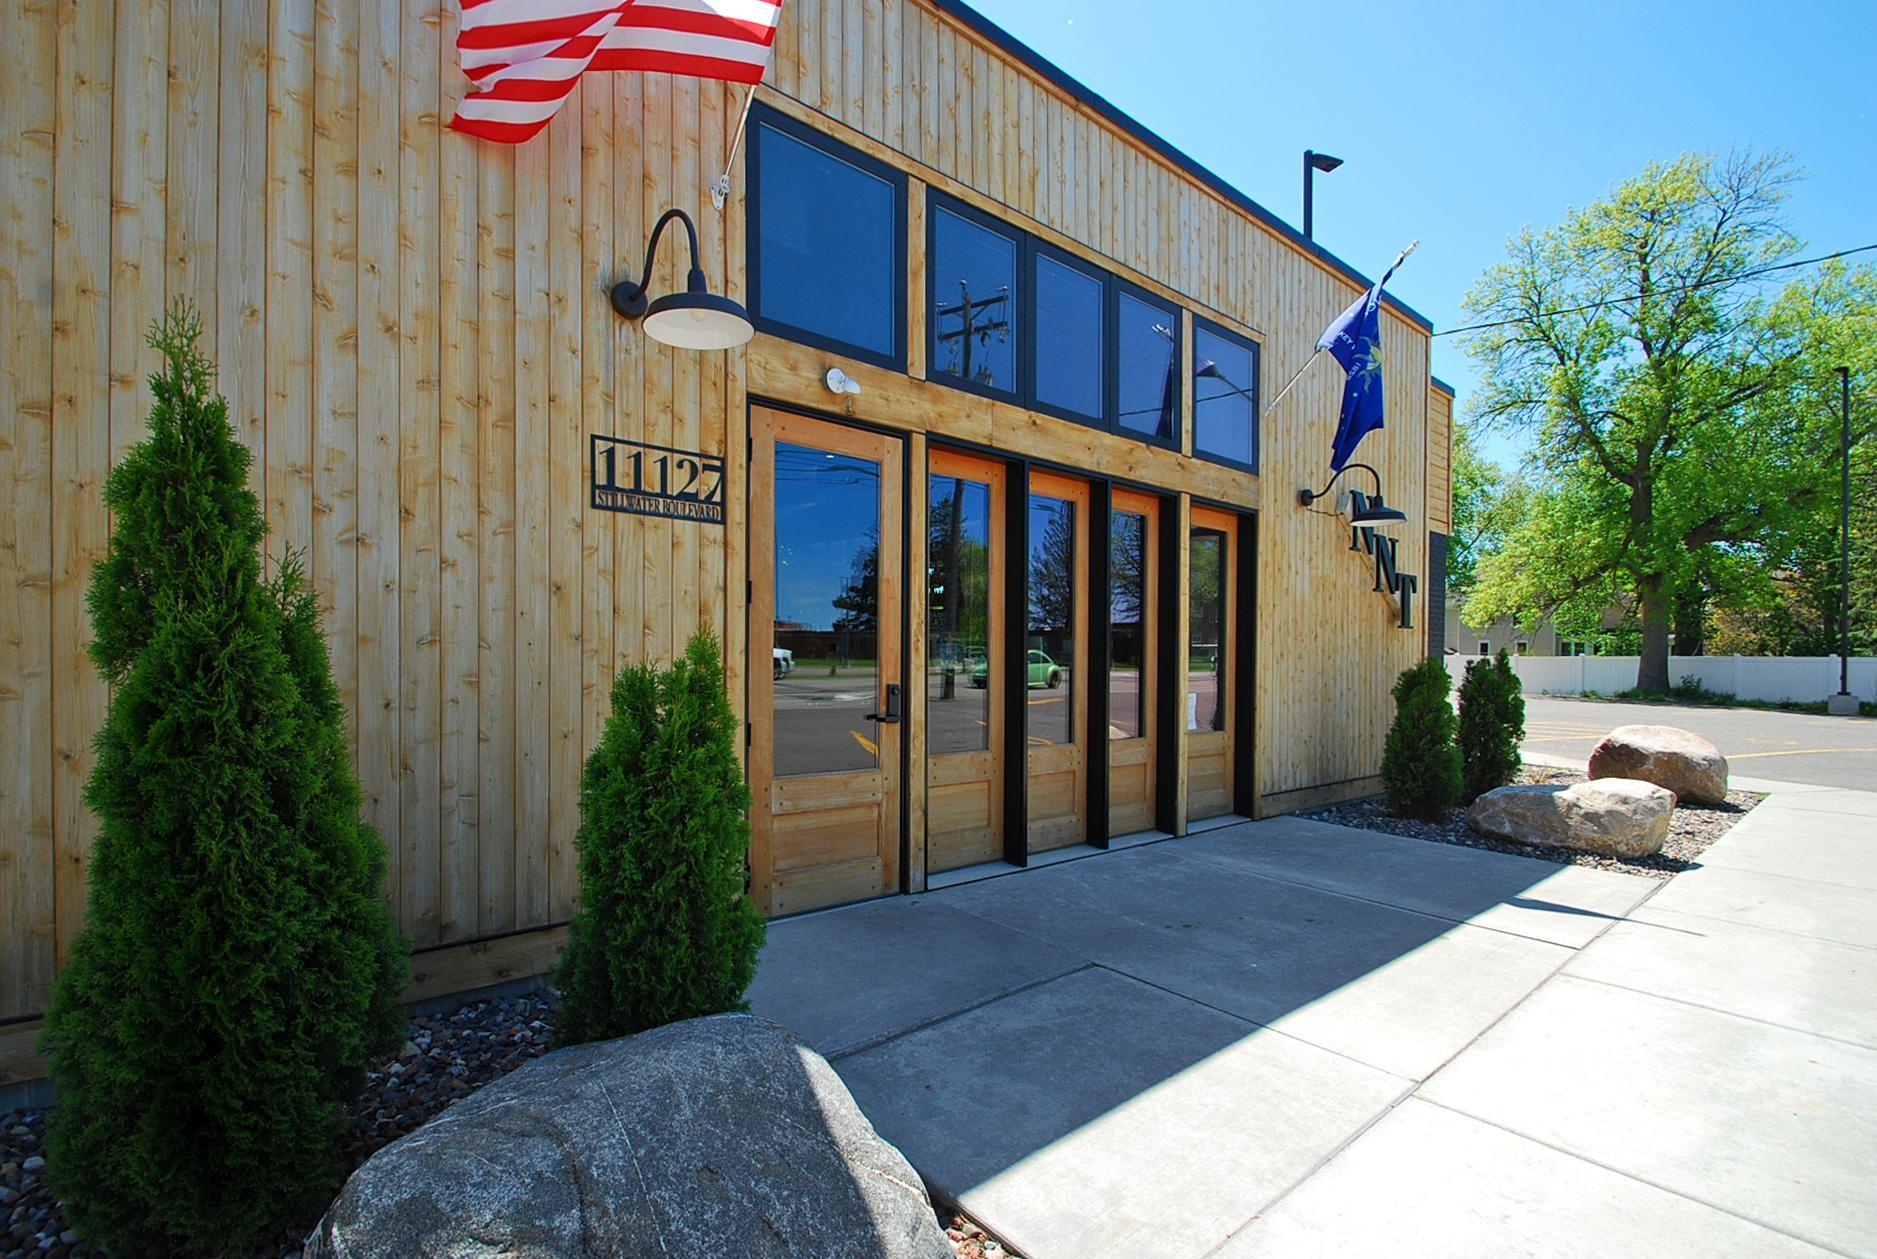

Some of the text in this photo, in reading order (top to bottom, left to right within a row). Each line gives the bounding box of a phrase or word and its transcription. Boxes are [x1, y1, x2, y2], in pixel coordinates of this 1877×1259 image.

[599, 446, 722, 502] 11127
[598, 490, 720, 521] STILLWATER BOULEVARD
